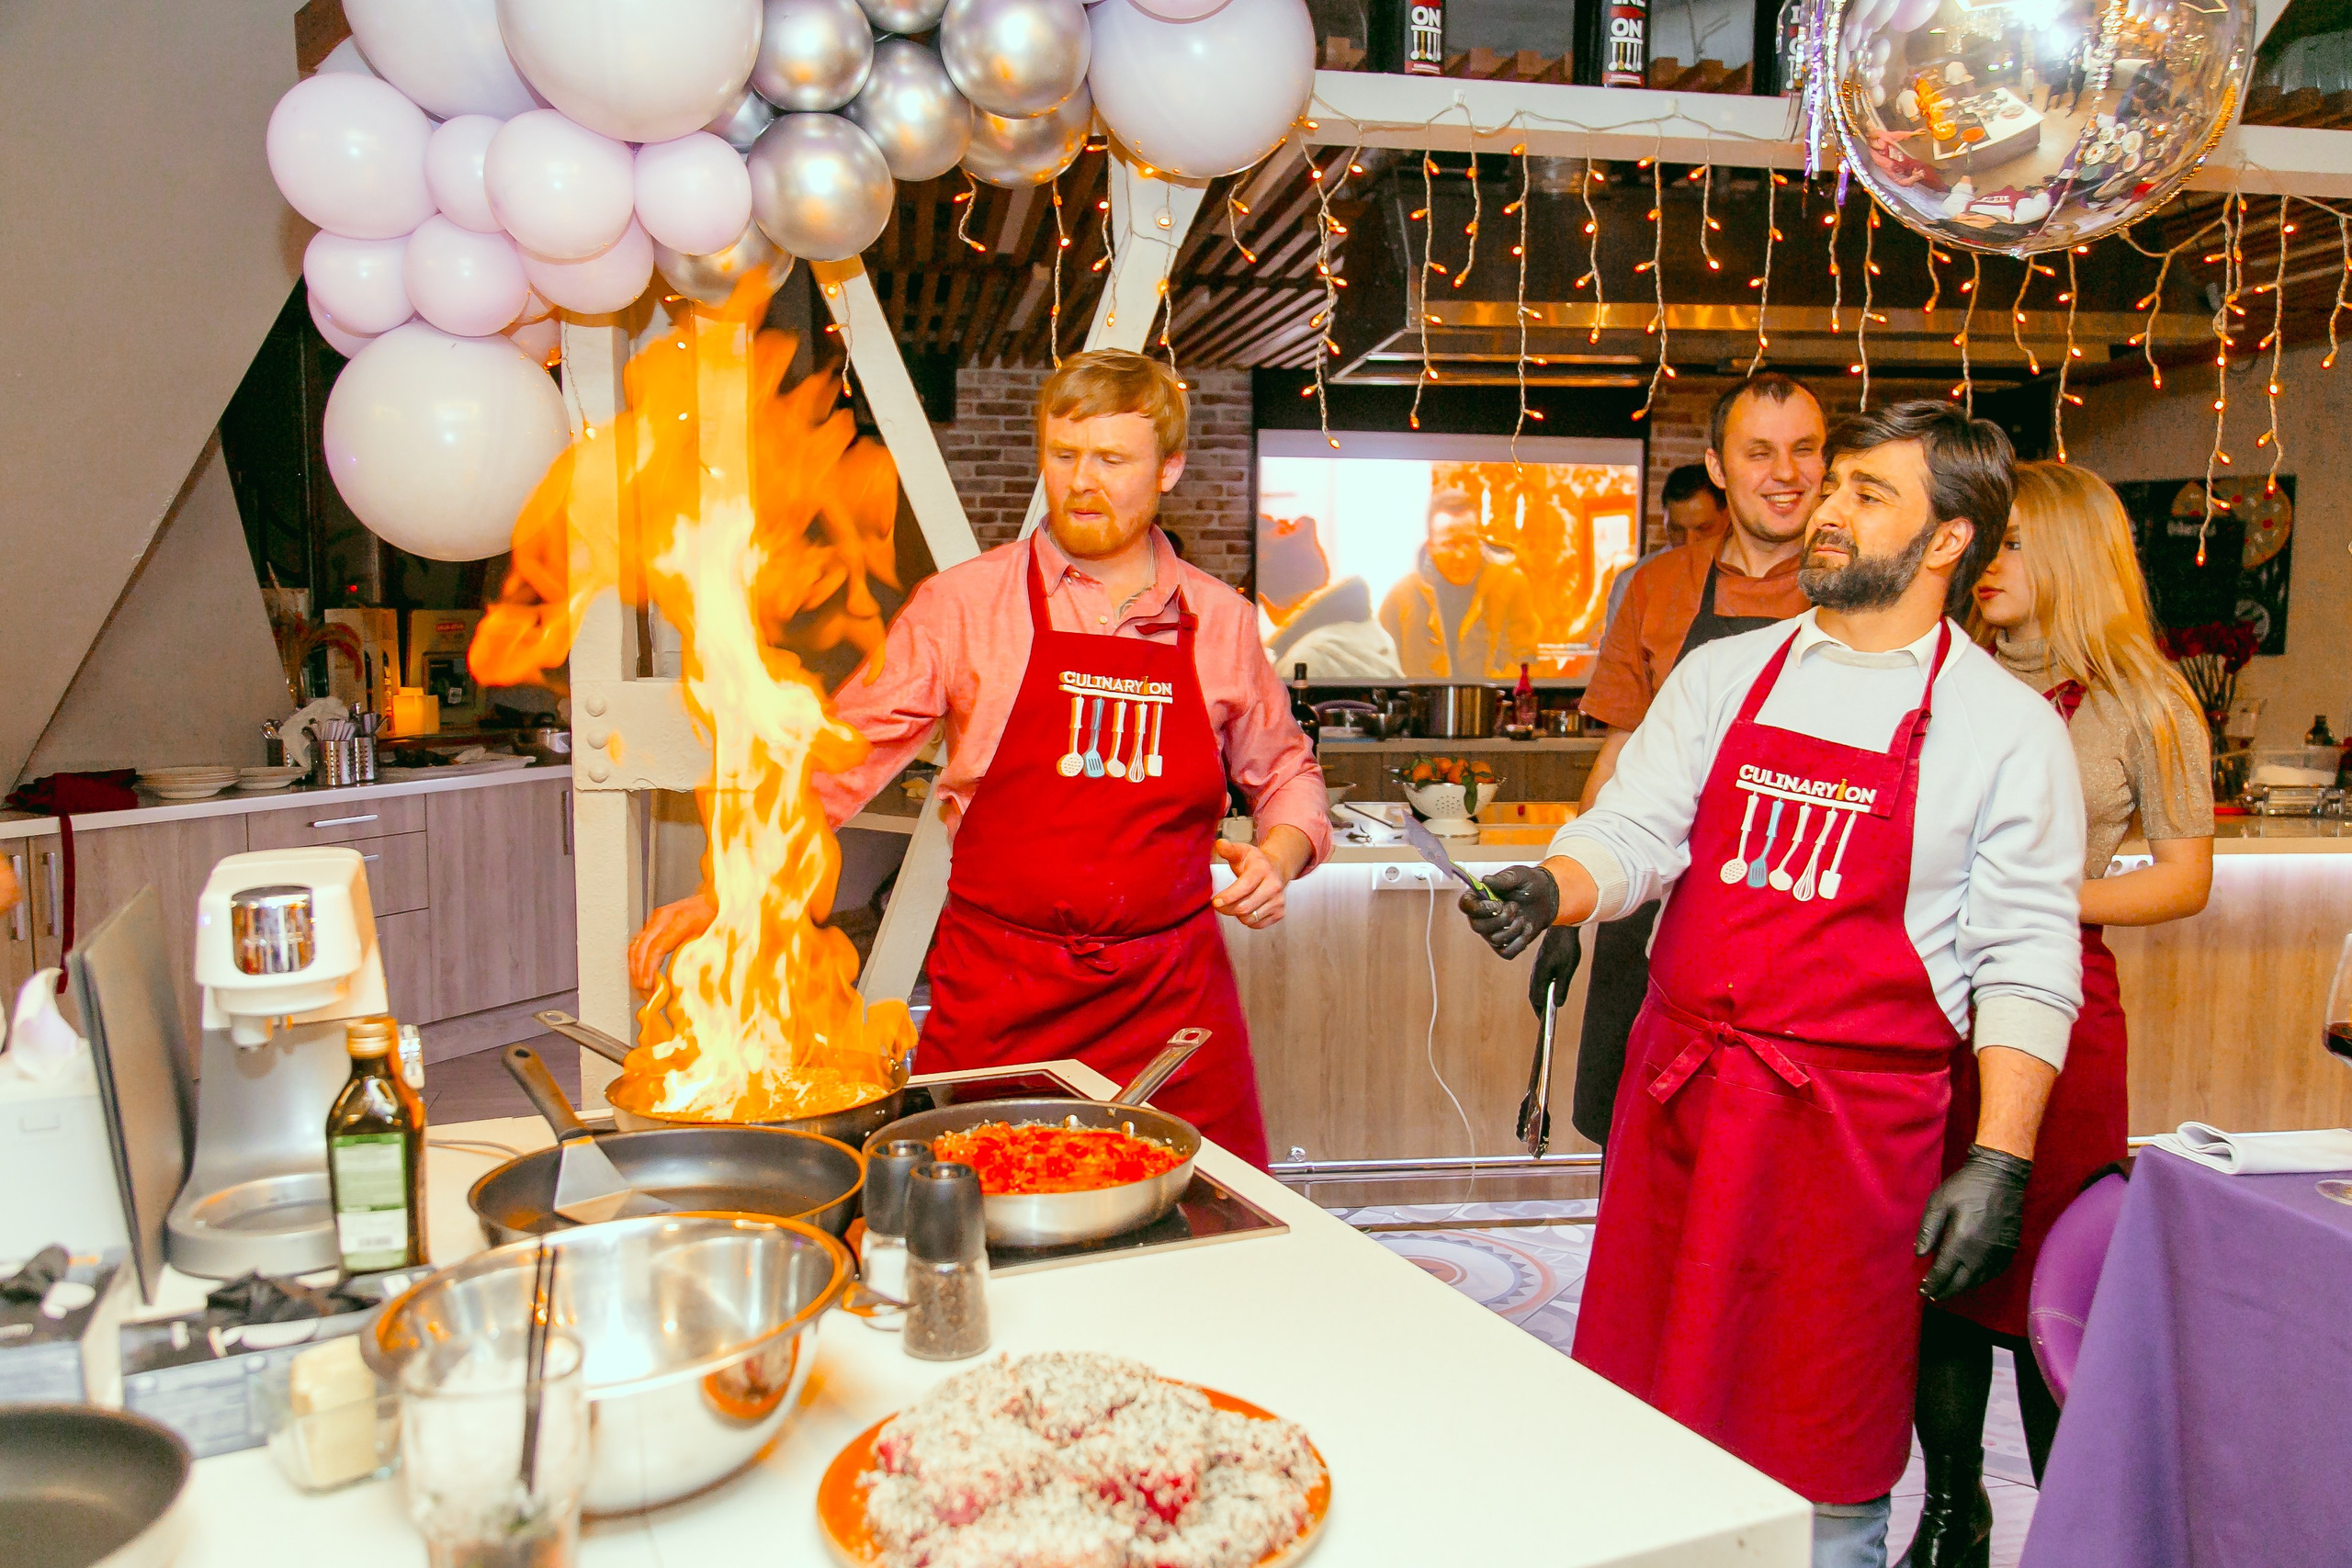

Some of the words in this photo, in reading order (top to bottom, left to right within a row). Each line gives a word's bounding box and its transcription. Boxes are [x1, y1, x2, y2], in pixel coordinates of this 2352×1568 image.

[1411, 6, 1441, 28] ON
[1611, 17, 1643, 39] ON
[1059, 671, 1144, 694] CULINARY
[1148, 682, 1173, 695] ON
[1738, 764, 1838, 798] CULINARY
[1844, 786, 1877, 804] ON
